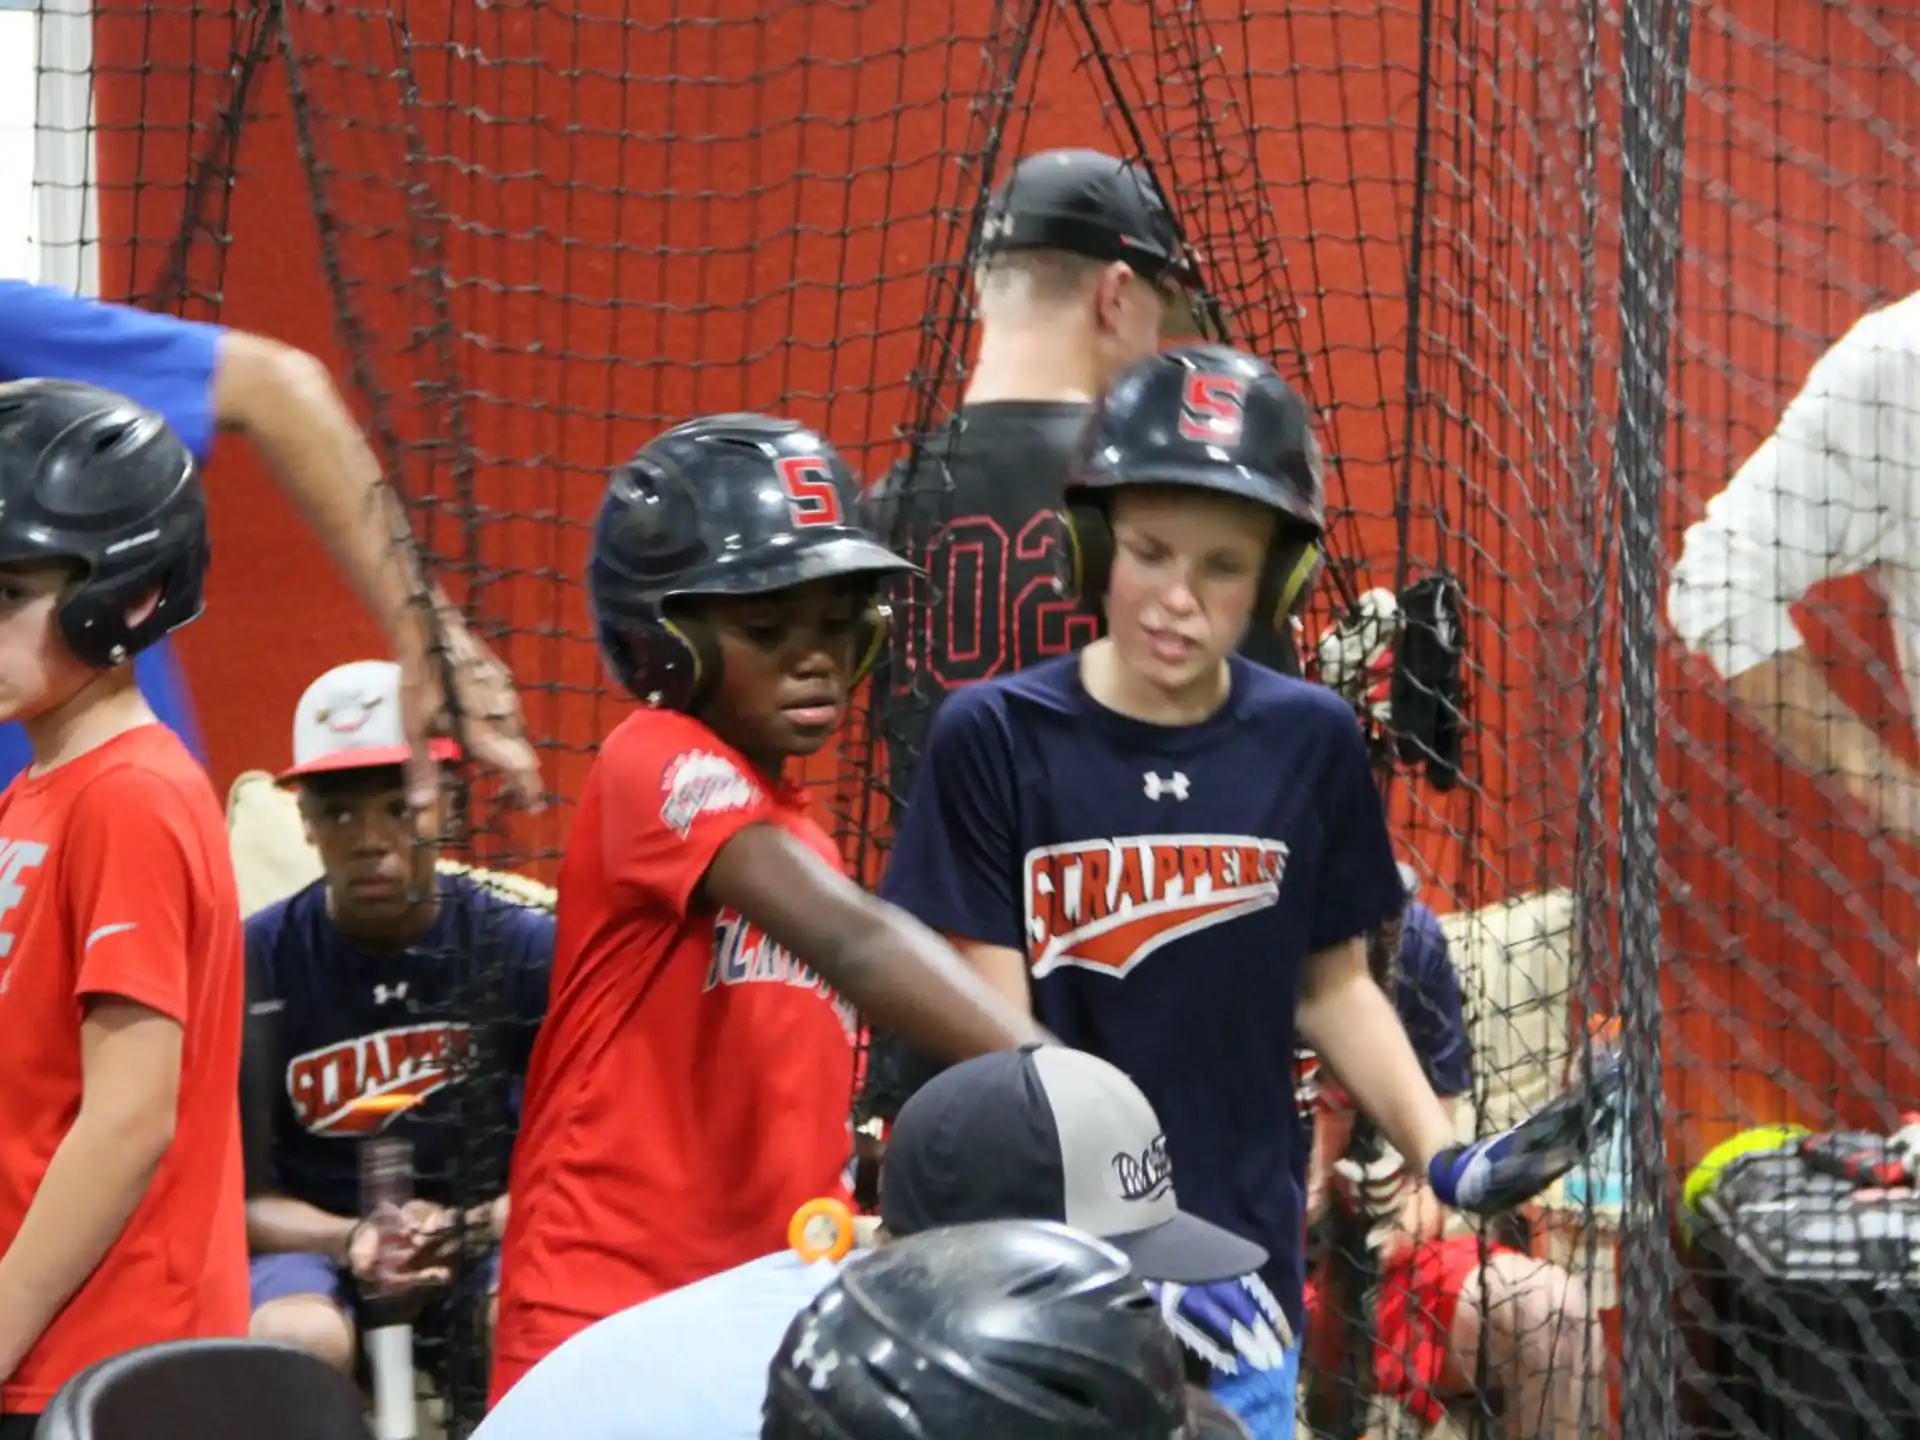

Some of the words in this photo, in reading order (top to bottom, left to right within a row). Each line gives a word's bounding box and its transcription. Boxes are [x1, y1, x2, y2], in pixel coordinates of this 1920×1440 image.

[1179, 370, 1247, 446] S
[774, 456, 844, 528] S
[1026, 840, 1288, 964] SCRAPPERS
